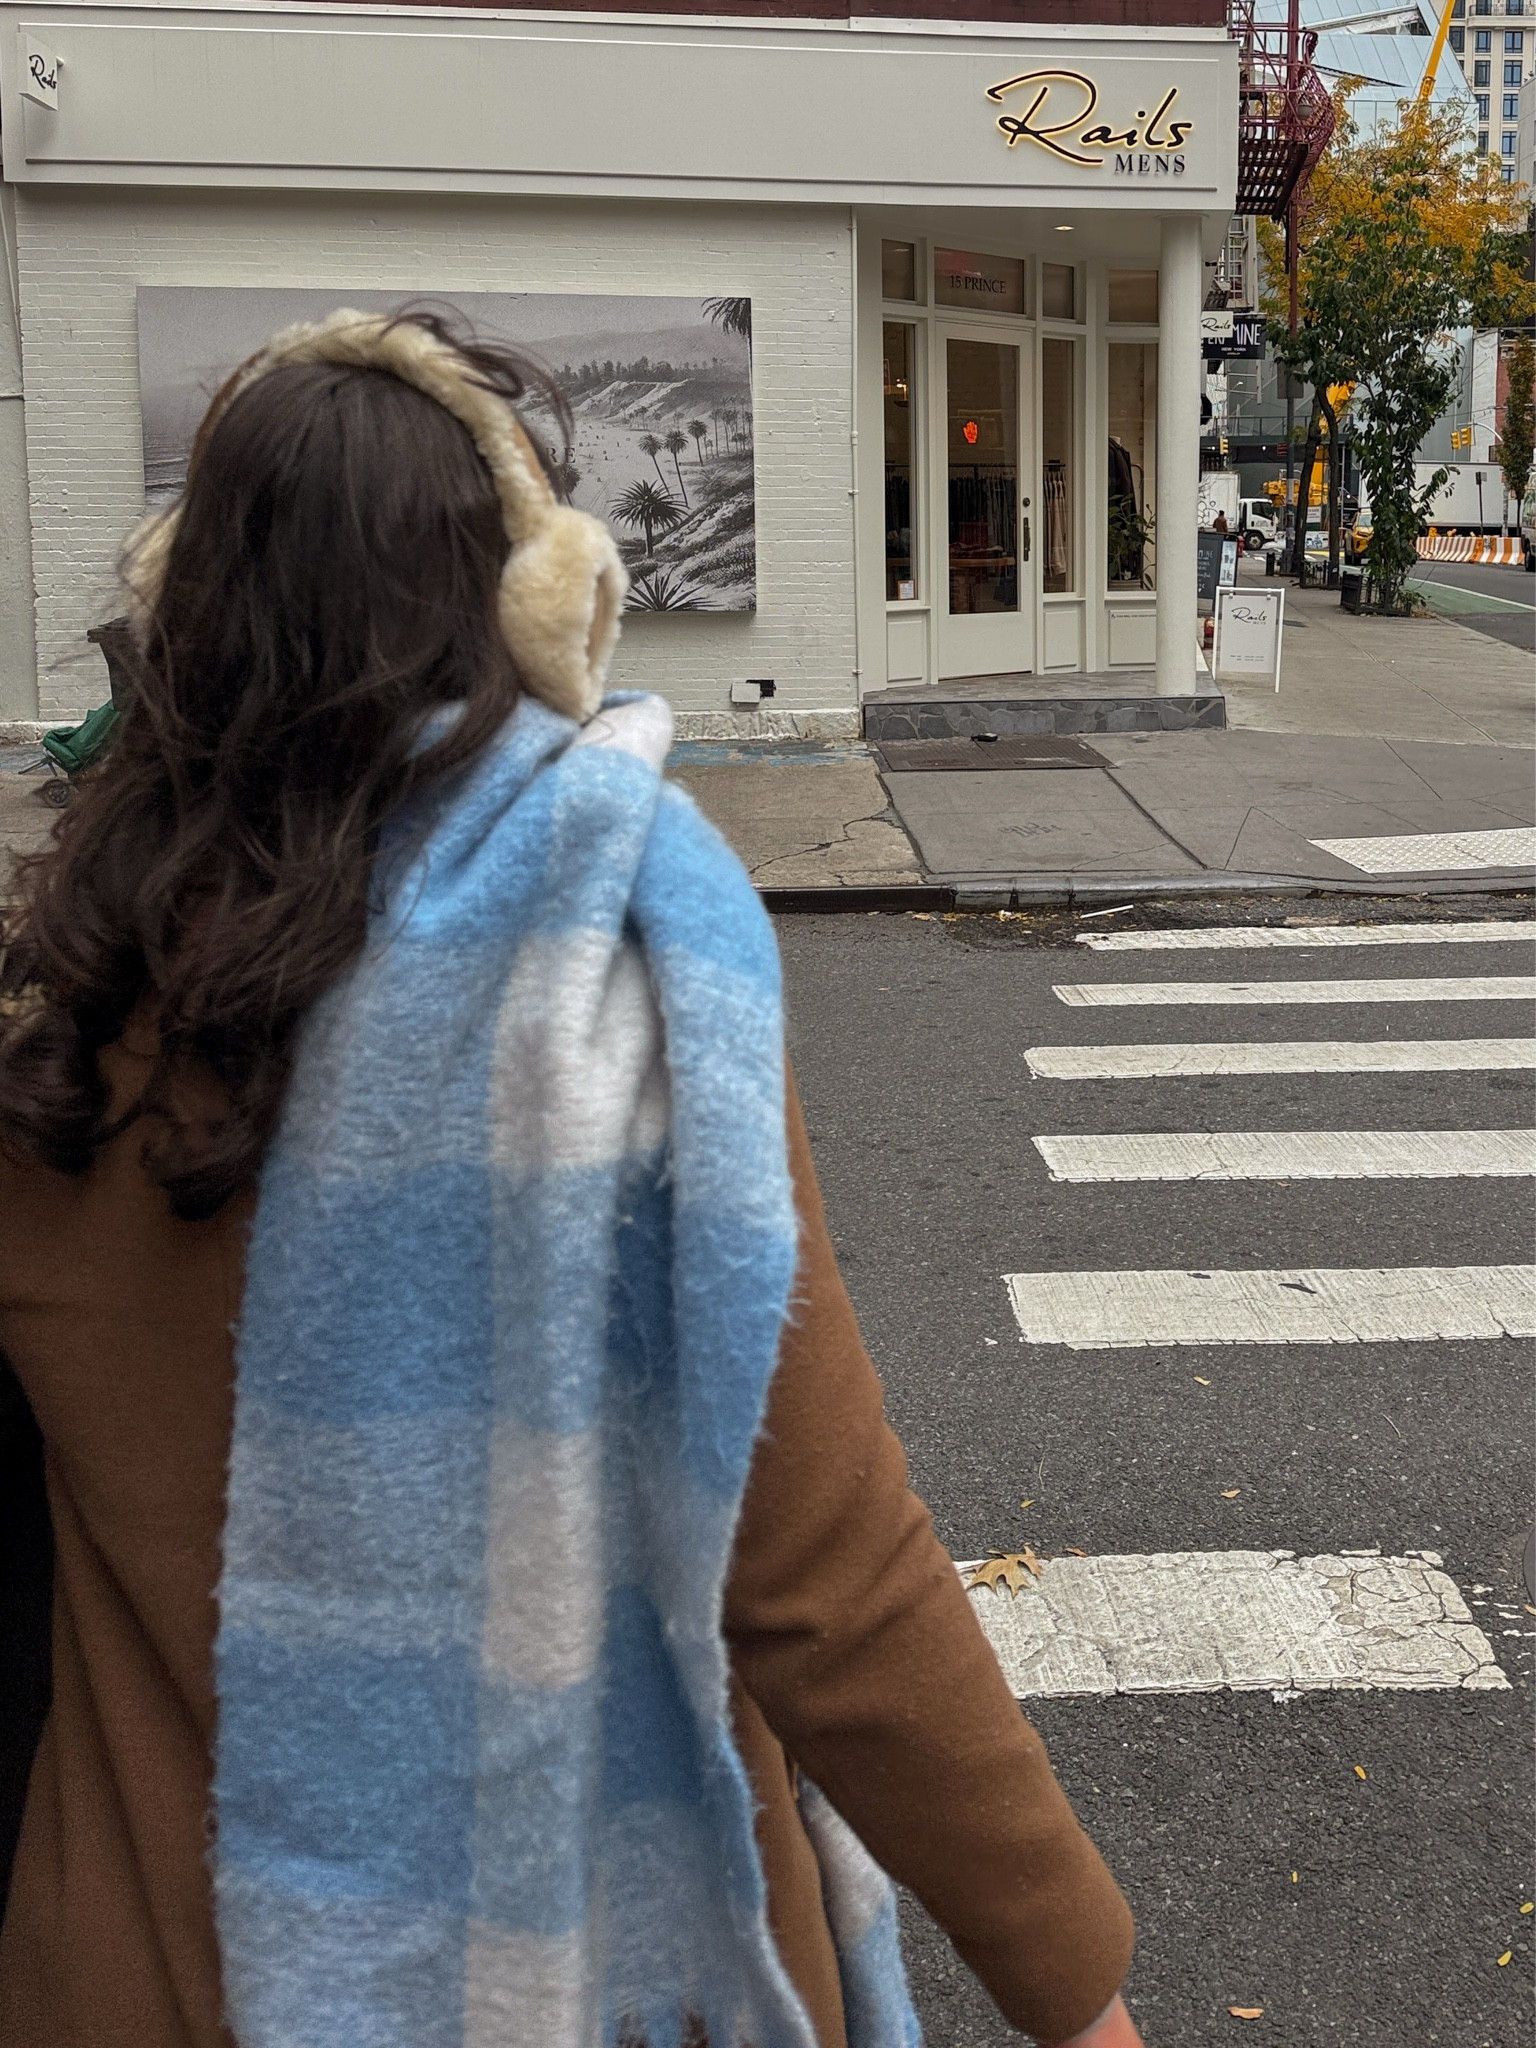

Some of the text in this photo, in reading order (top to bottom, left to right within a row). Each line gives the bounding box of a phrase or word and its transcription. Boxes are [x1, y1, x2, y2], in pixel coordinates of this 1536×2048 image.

[29, 54, 58, 90] Rails
[986, 69, 1192, 164] Rails
[1115, 153, 1186, 173] MENS
[950, 275, 1007, 294] 15 PRINCE
[1201, 317, 1231, 332] Rails
[1231, 606, 1267, 623] Rails
